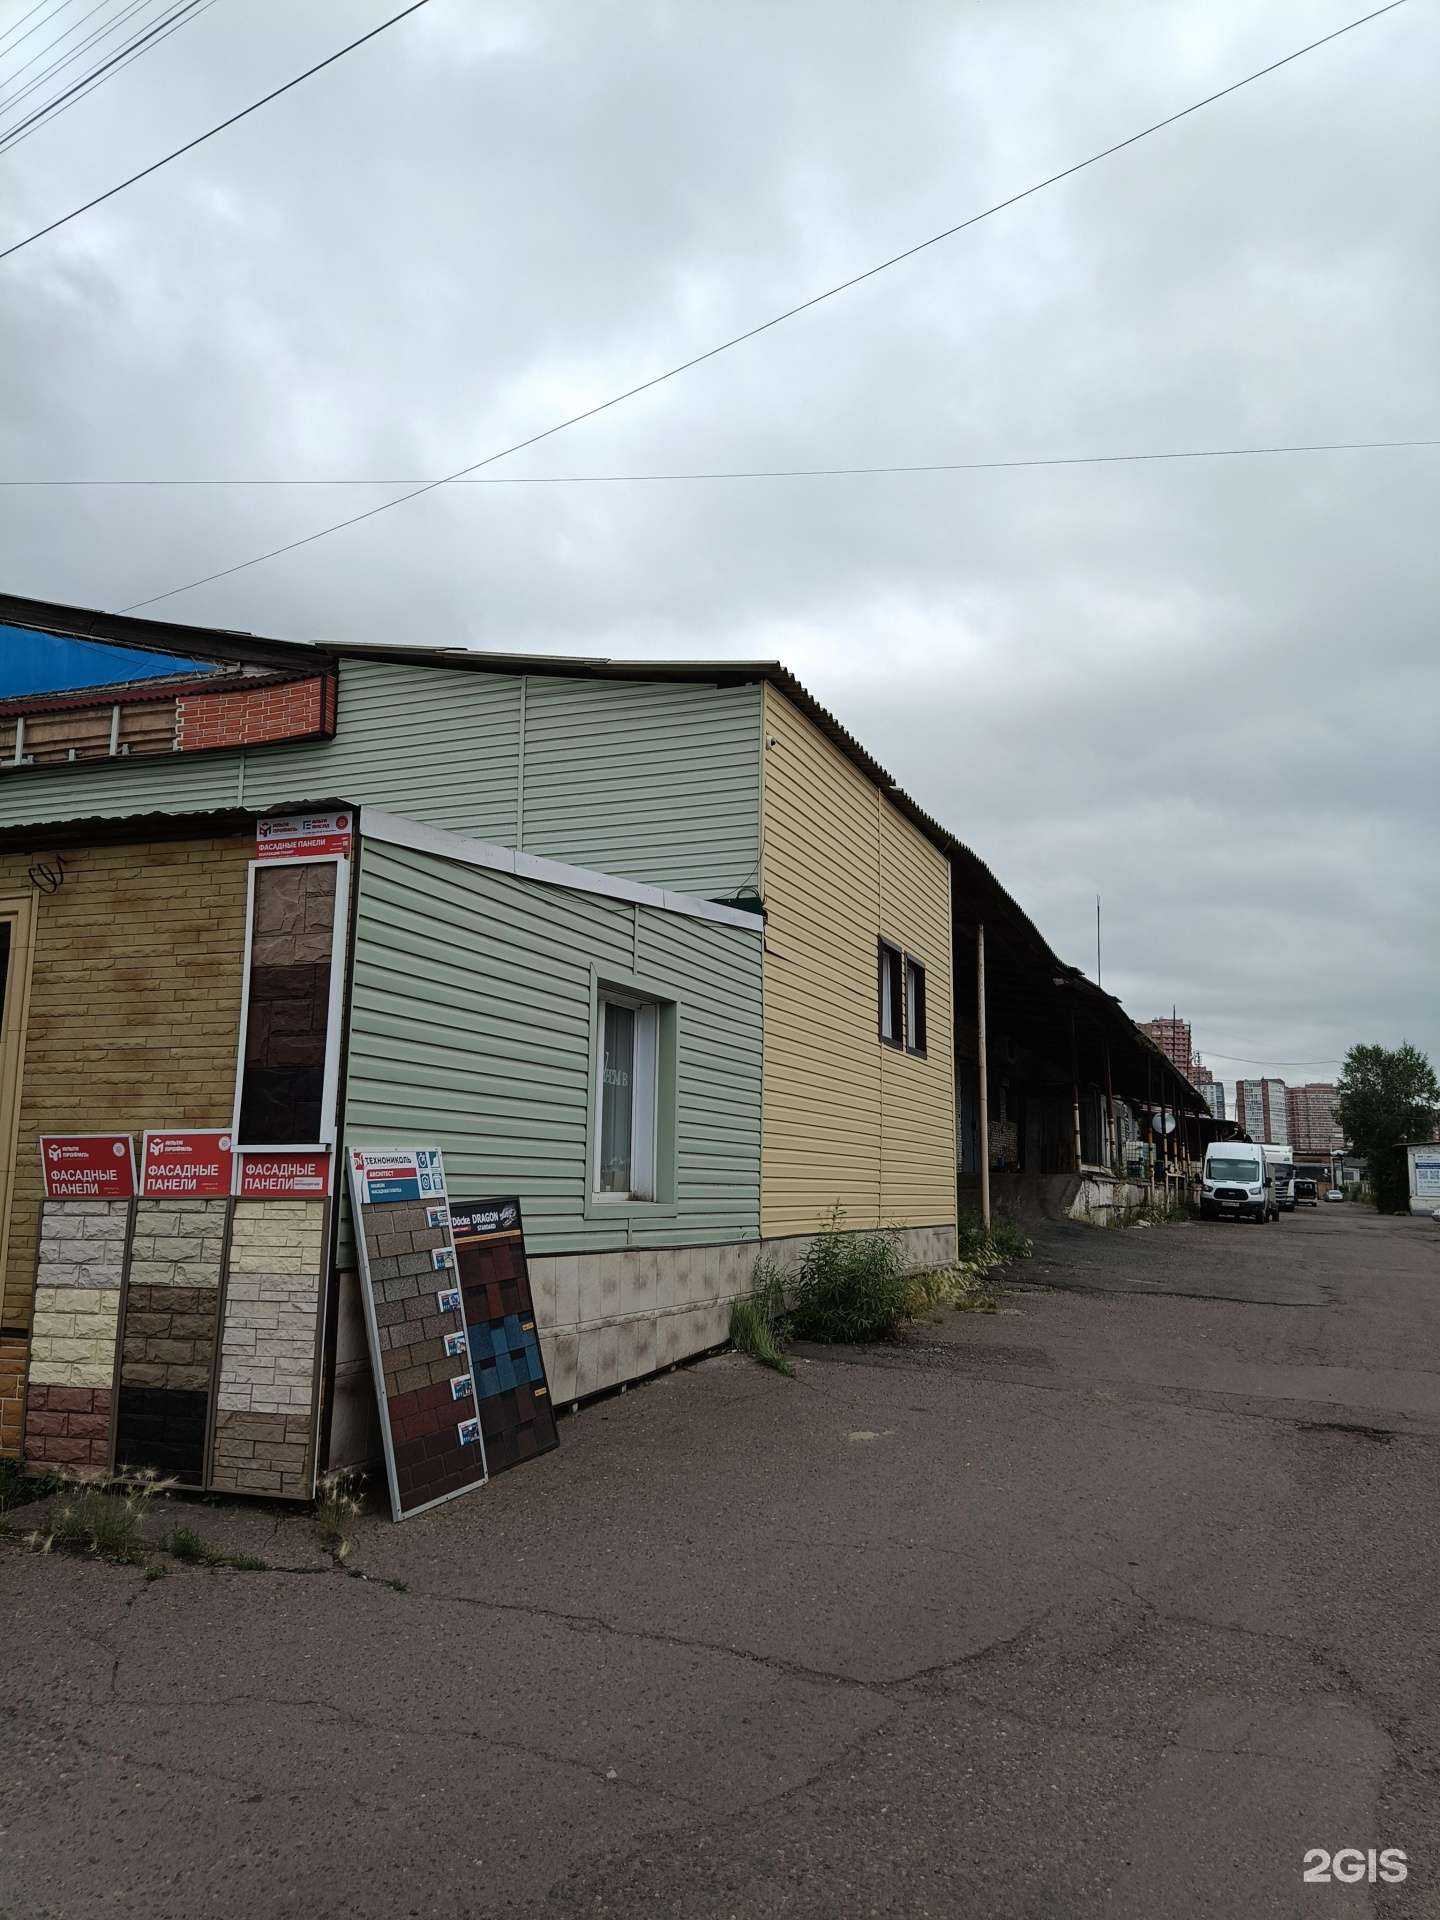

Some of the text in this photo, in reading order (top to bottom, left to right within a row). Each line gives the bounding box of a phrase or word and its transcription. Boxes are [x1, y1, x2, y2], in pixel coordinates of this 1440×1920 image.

[258, 841, 297, 851] ФАСАДНЫЕ
[298, 838, 326, 848] ПАНЕЛИ
[365, 1156, 412, 1165] ТЕХНОНИКОЛЬ
[50, 1169, 118, 1182] ФАСАДНЫЕ
[148, 1164, 219, 1177] ФАСАДНЫЕ
[246, 1163, 316, 1177] ФАСАДНЫЕ
[52, 1183, 99, 1194] ПАНЕЛИ
[146, 1178, 197, 1190] ПАНЕЛИ
[244, 1178, 294, 1190] ПАНЕЛИ
[472, 1211, 499, 1224] DRAGON
